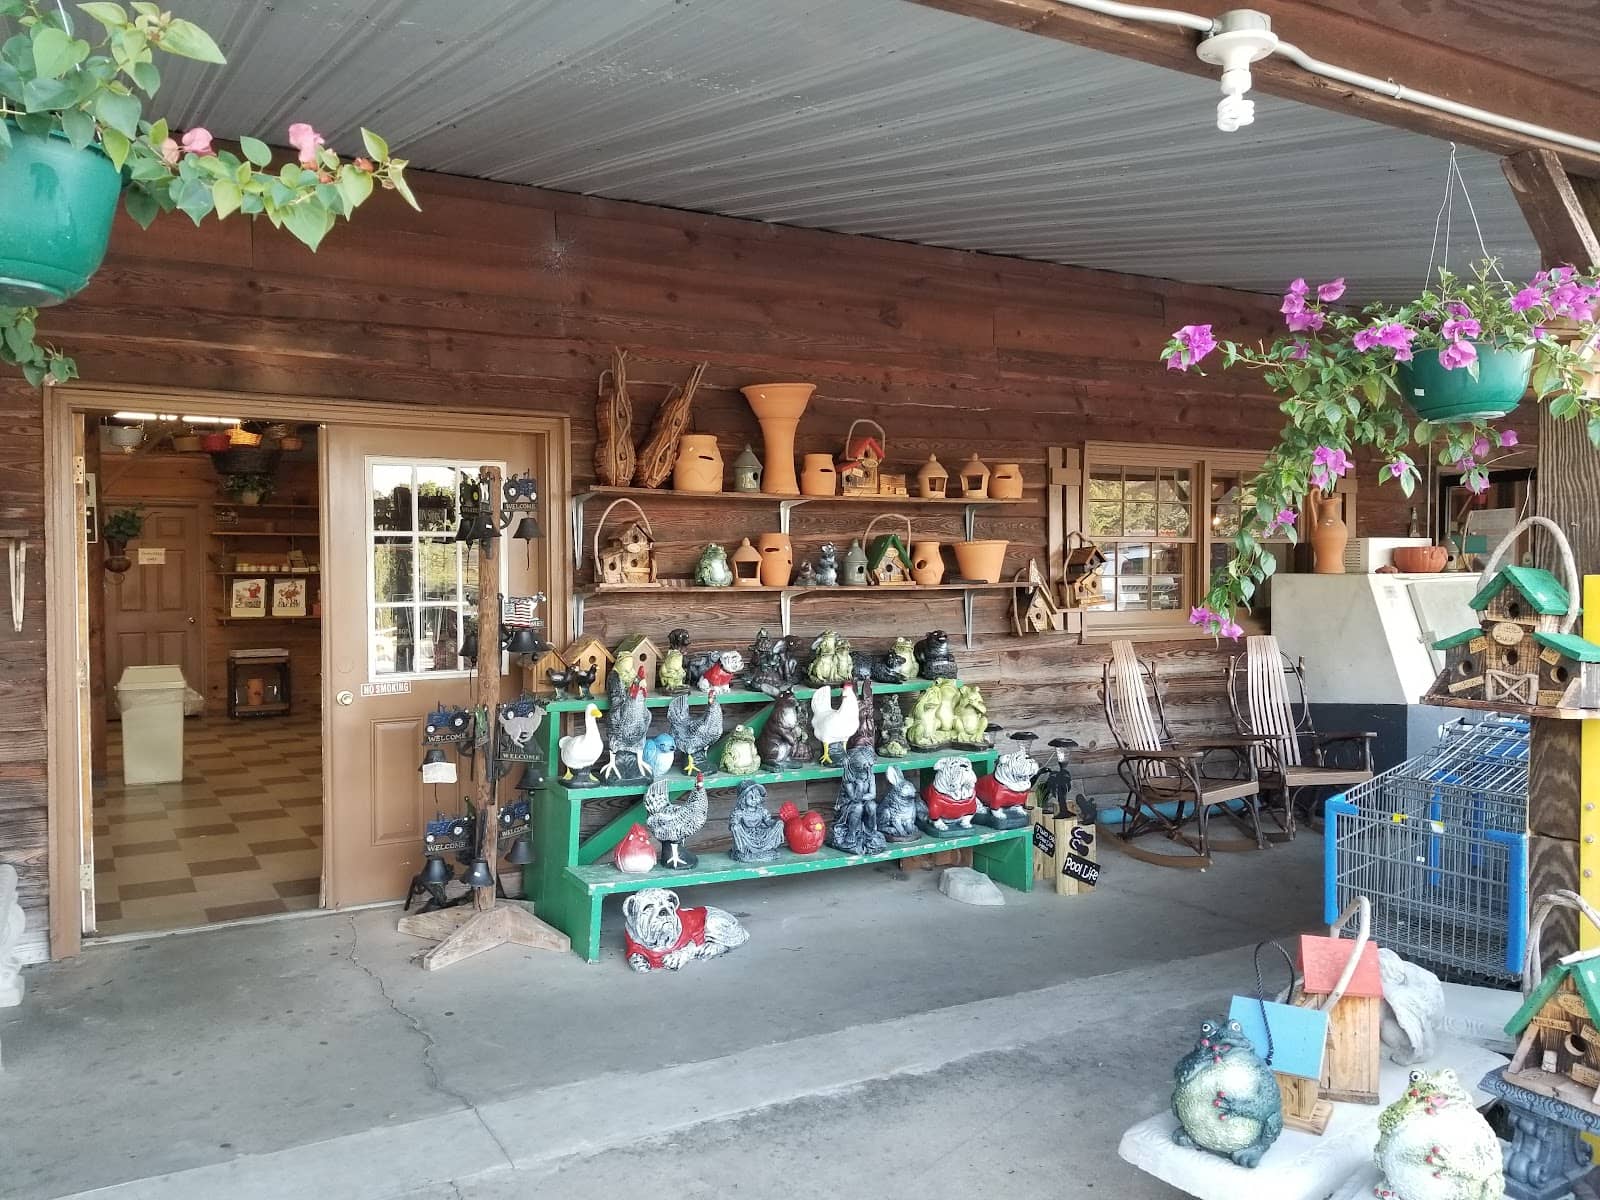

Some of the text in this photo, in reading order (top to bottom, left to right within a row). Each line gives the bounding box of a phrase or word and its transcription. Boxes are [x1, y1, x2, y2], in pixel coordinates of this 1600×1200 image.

[363, 682, 409, 694] NO SMOKING
[428, 734, 466, 743] WELCOME
[427, 841, 466, 852] WELCOME
[1064, 858, 1099, 880] Pool Life
